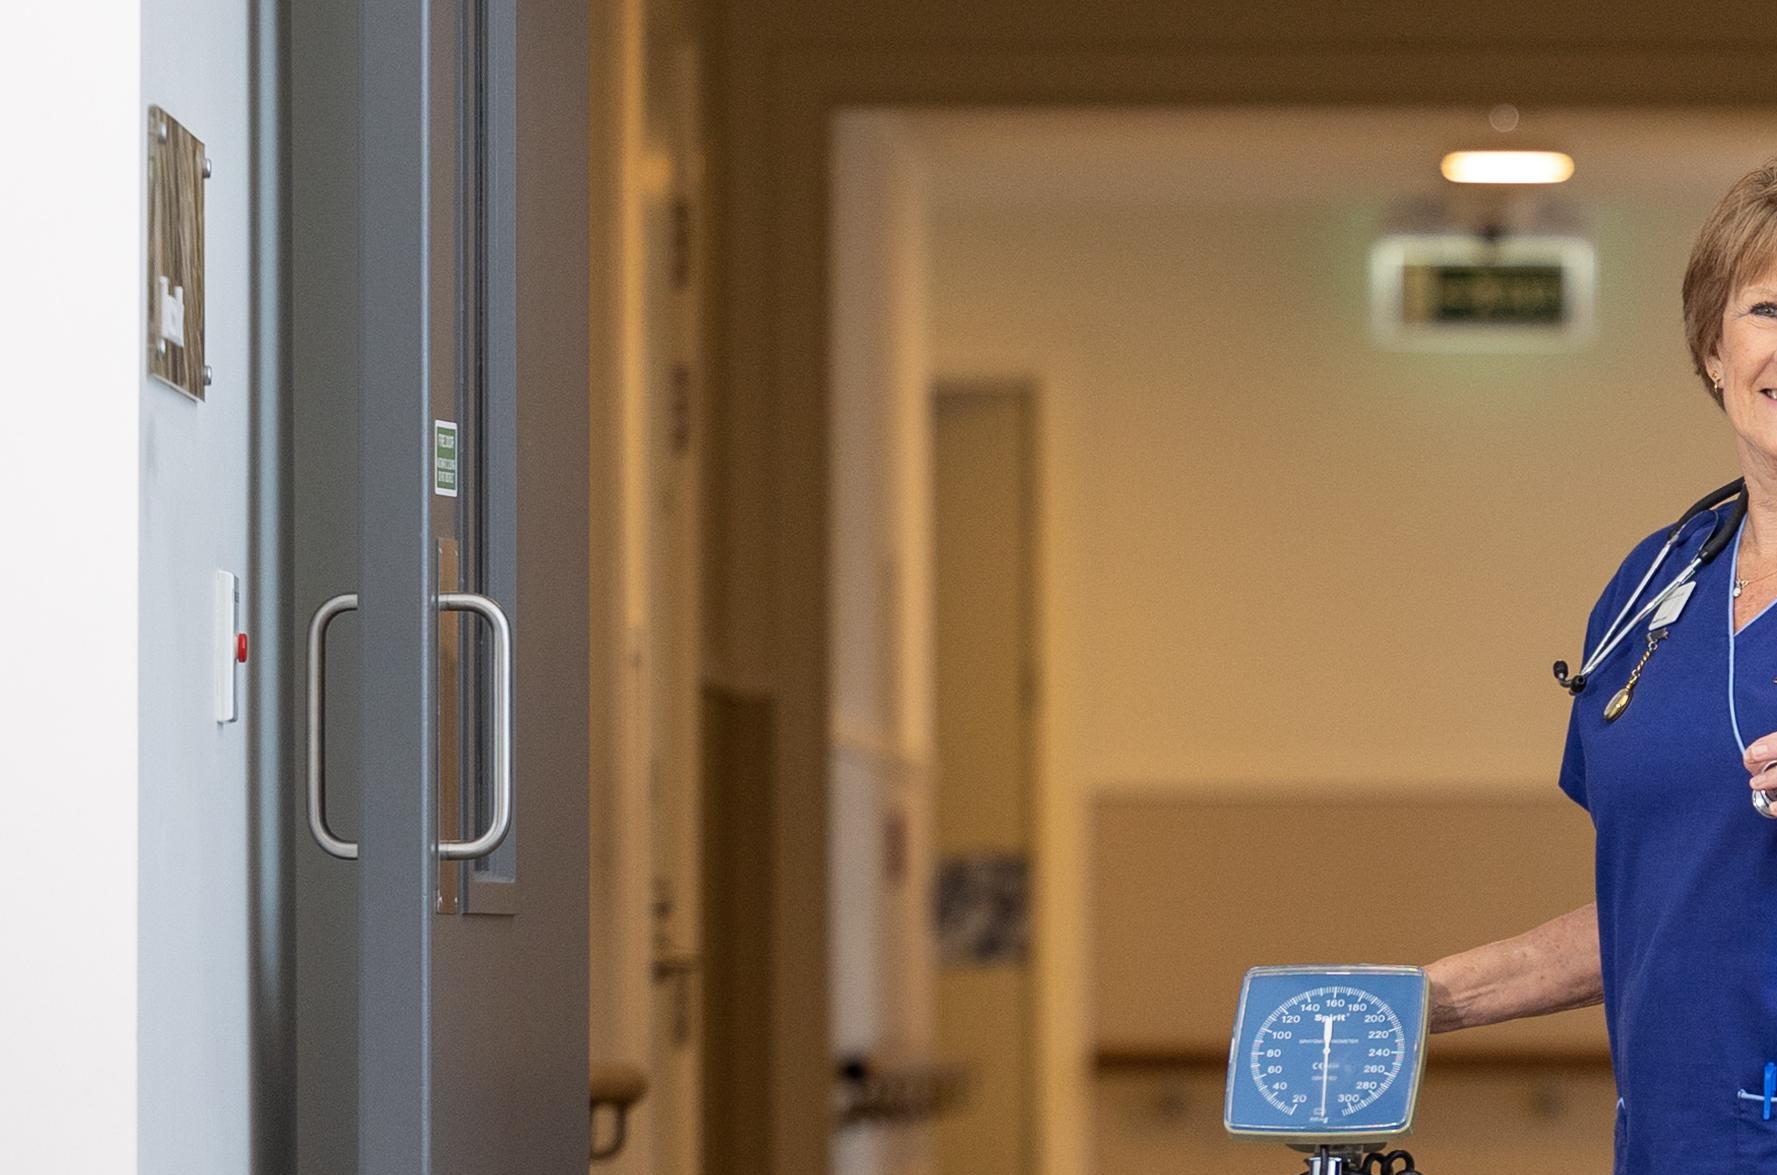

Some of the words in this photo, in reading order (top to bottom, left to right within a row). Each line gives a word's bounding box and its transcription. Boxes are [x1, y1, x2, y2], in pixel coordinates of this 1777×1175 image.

[1301, 1003, 1320, 1012] 140
[1326, 999, 1345, 1008] 160
[1348, 1003, 1367, 1012] 180
[1282, 1015, 1301, 1024] 120
[1314, 1013, 1346, 1023] Spirit
[1364, 1014, 1386, 1023] 200
[1272, 1031, 1292, 1040] 100
[1368, 1030, 1389, 1039] 220
[1266, 1048, 1282, 1058] 80
[1368, 1048, 1390, 1057] 240
[1267, 1065, 1282, 1074] 60
[1363, 1064, 1385, 1073] 260
[1272, 1081, 1288, 1090] 40
[1356, 1081, 1377, 1090] 280
[1292, 1094, 1307, 1103] 20
[1337, 1094, 1360, 1103] 300
